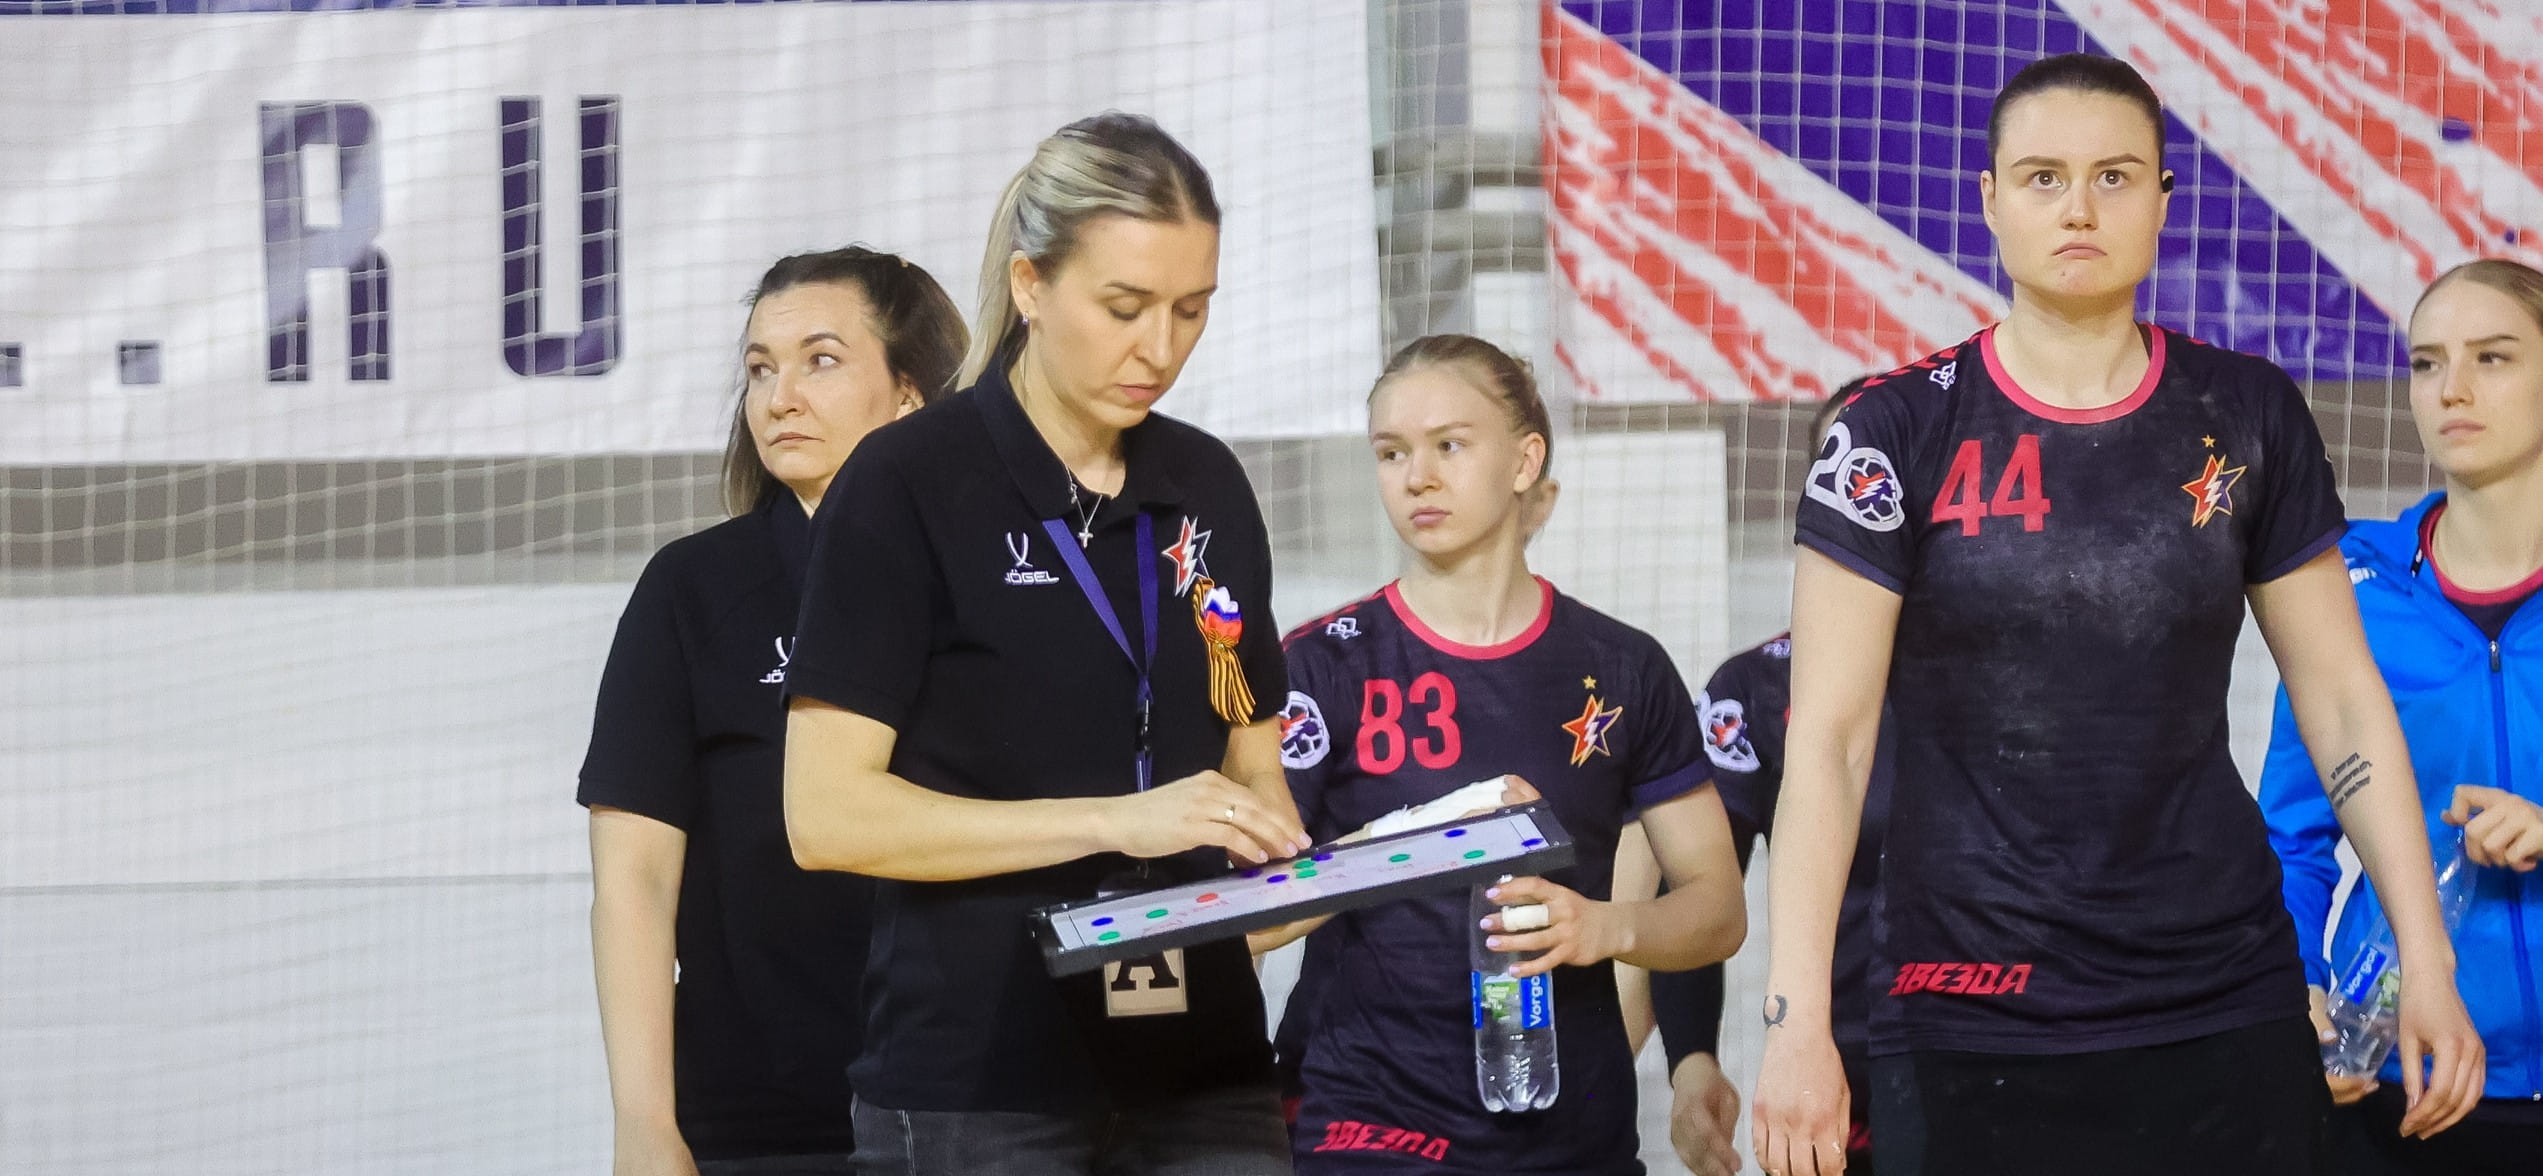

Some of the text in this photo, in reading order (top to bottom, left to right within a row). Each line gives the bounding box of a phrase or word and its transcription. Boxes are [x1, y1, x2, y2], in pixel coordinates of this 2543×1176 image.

[1931, 433, 2051, 537] 44
[1004, 568, 1060, 585] JÖGEL
[1356, 671, 1462, 775] 83
[1888, 961, 2033, 997] ЗВЕЗДА
